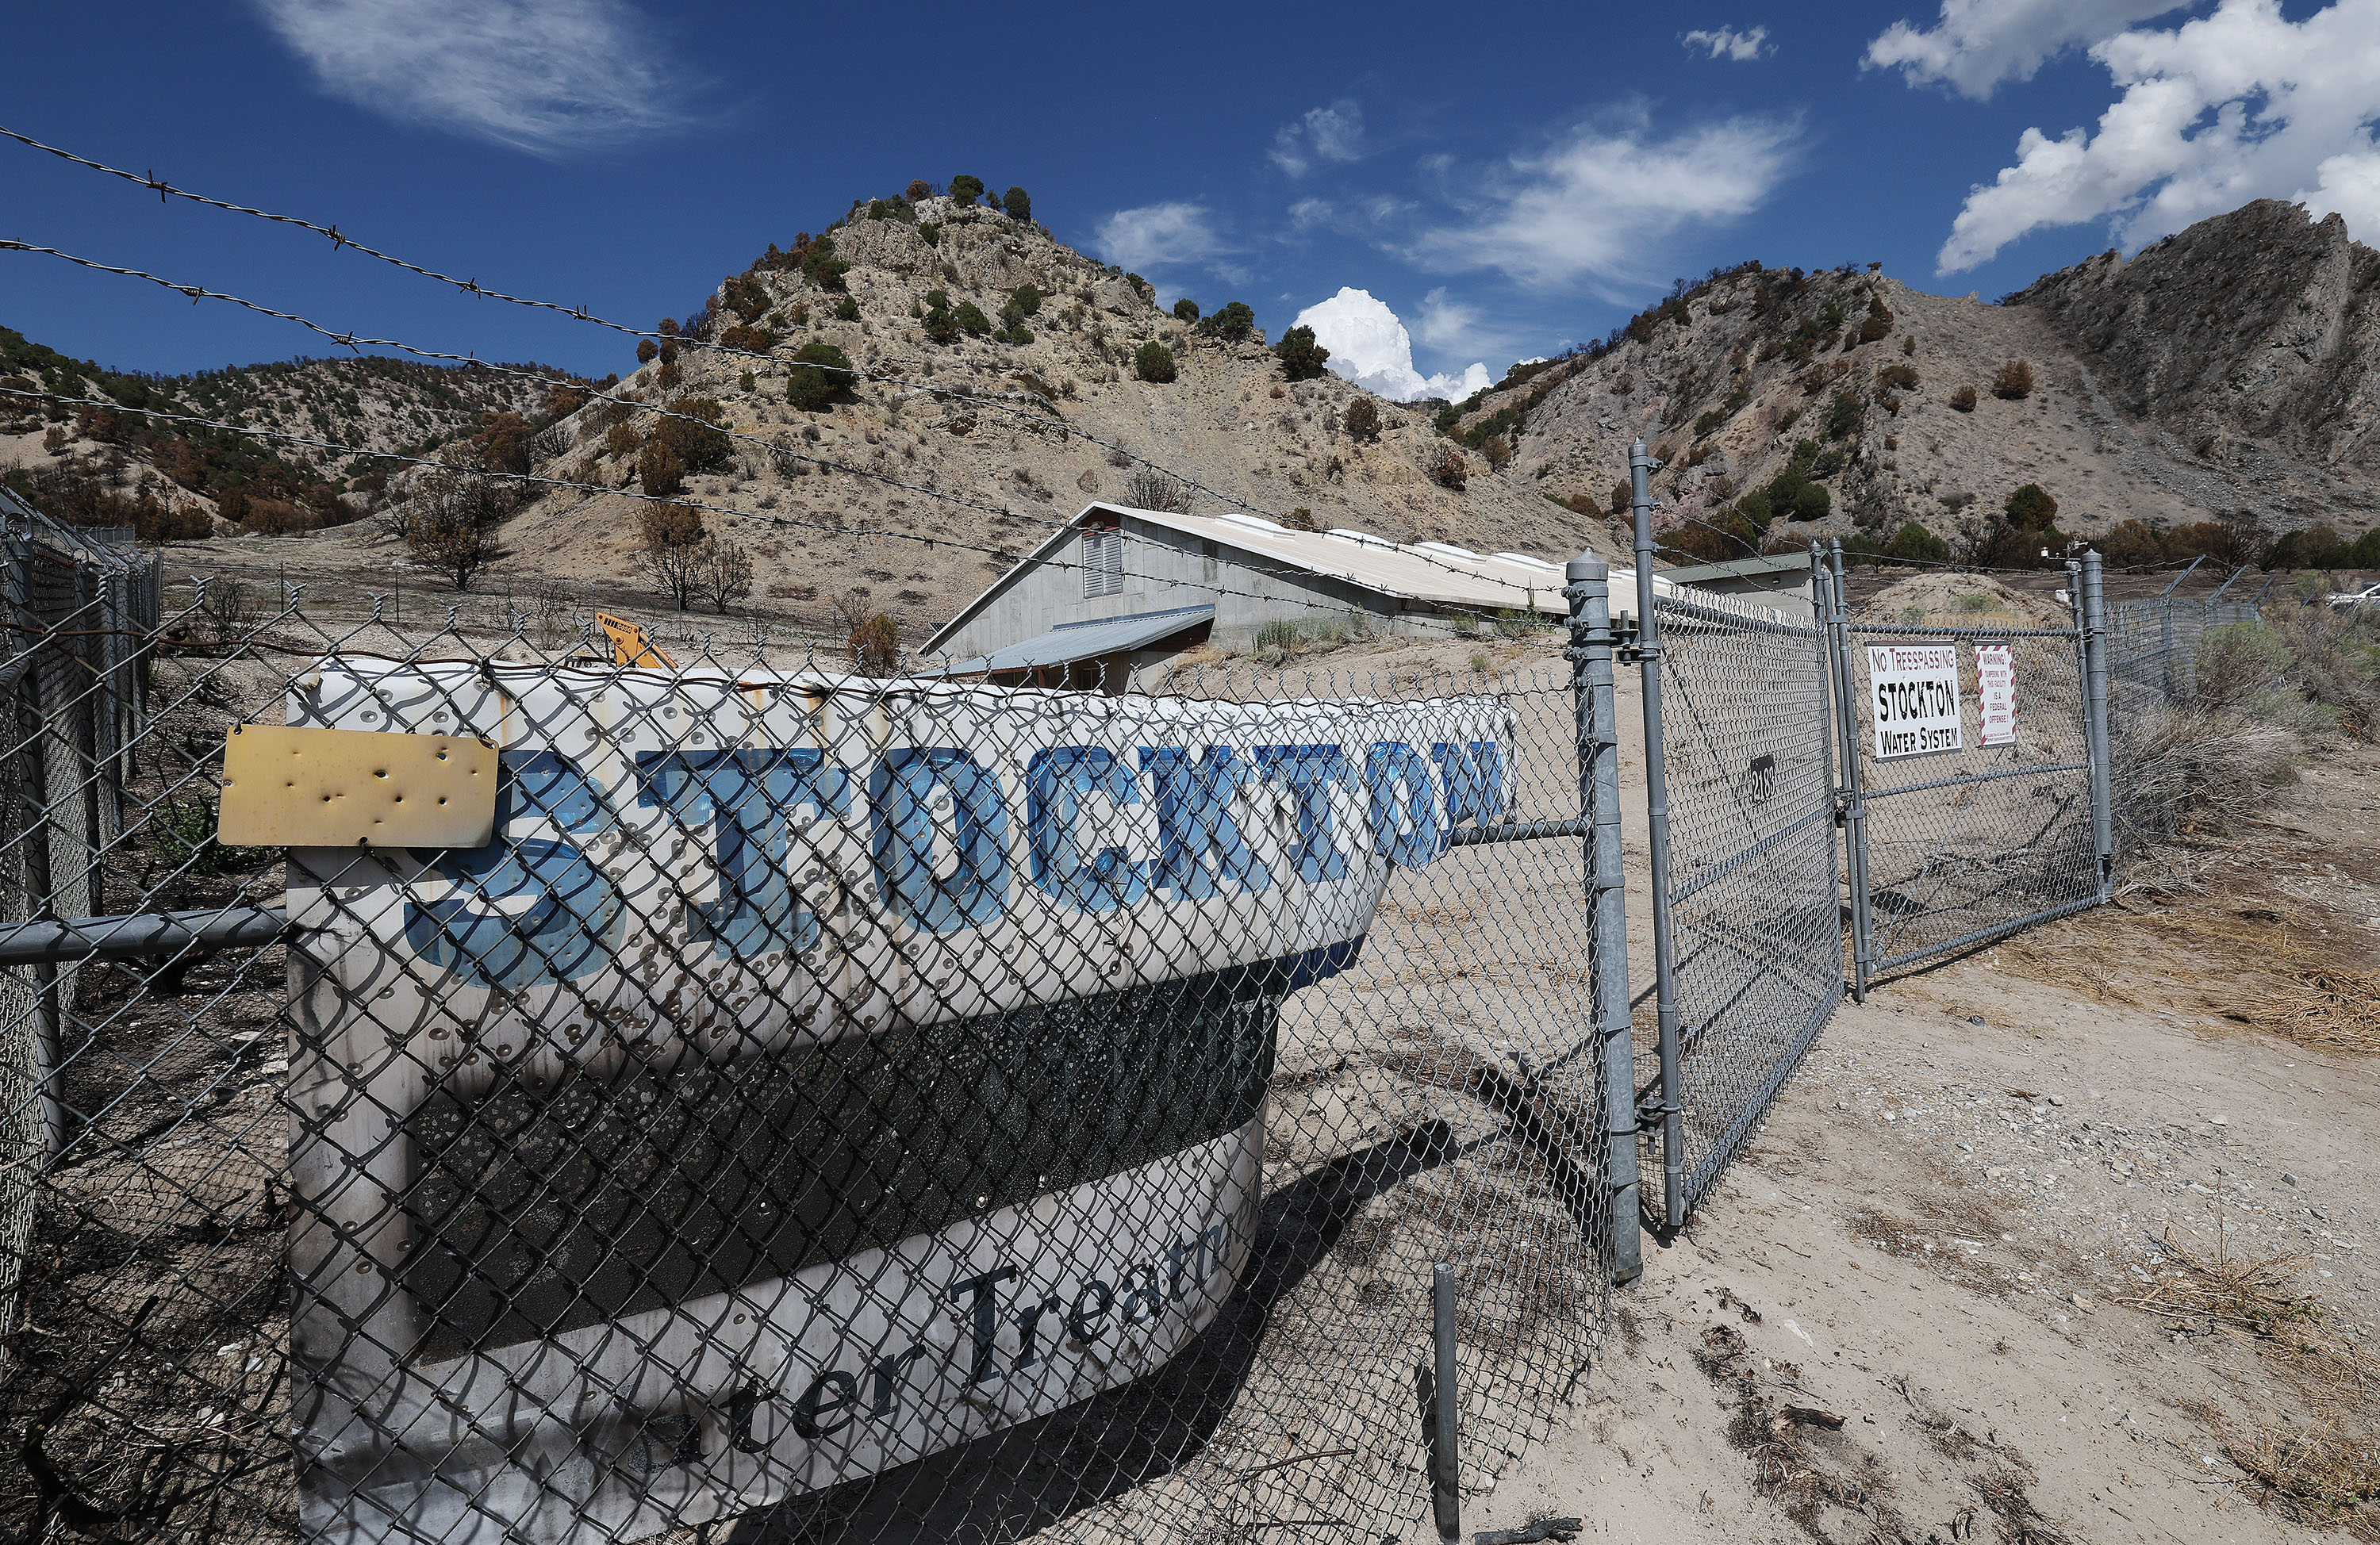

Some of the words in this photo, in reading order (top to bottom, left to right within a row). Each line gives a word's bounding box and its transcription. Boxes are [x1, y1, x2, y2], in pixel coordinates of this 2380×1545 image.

[1871, 648, 1887, 673] NO
[1983, 653, 2007, 665] WARNING!
[1879, 680, 1956, 722] STOCKTON
[1880, 730, 1917, 755] WATER
[1920, 726, 1958, 750] SYSTEM
[1752, 766, 1775, 802] 2183
[403, 742, 1506, 989] STOCKTON
[625, 1342, 927, 1475] ater
